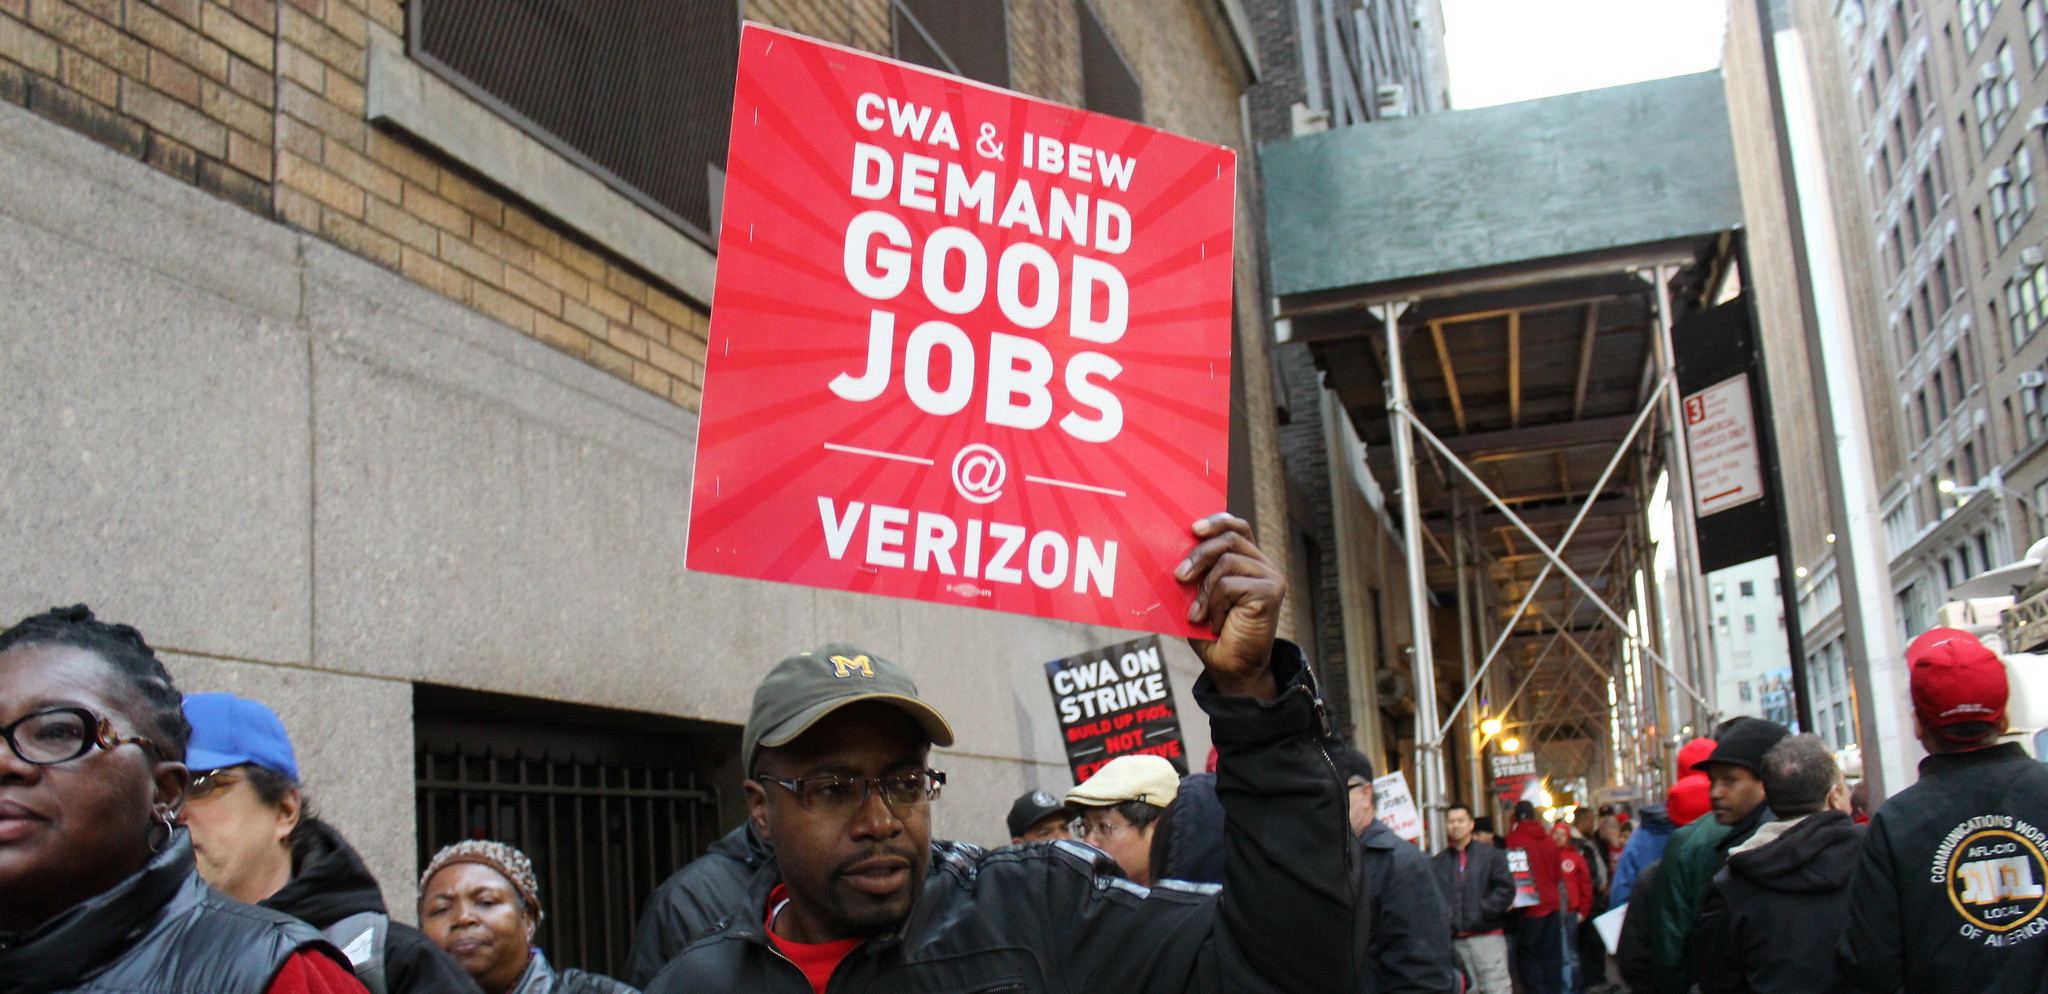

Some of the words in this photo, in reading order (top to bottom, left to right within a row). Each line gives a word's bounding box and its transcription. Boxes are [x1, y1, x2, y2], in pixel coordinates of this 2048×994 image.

[856, 93, 960, 151] CWA
[975, 122, 1005, 162] &
[1022, 131, 1137, 192] IBEW
[850, 142, 1132, 255] DEMAND
[843, 210, 1130, 344] GOOD
[828, 309, 1124, 443] JOBS
[1689, 399, 1702, 421] 3
[951, 443, 1006, 504] @
[817, 496, 1119, 598] VERIZON
[828, 654, 876, 679] M
[1053, 658, 1120, 696] CWA
[1120, 646, 1161, 678] ON
[1059, 672, 1168, 724] STRIKE
[1066, 718, 1112, 742] BUILD
[1113, 712, 1134, 730] UP
[1104, 728, 1144, 754] NOT
[1493, 762, 1537, 778] STRIKE
[1929, 814, 2014, 884] COMMUNICATIONS
[1959, 923, 1983, 940] OF
[1983, 904, 2024, 919] LOCAL
